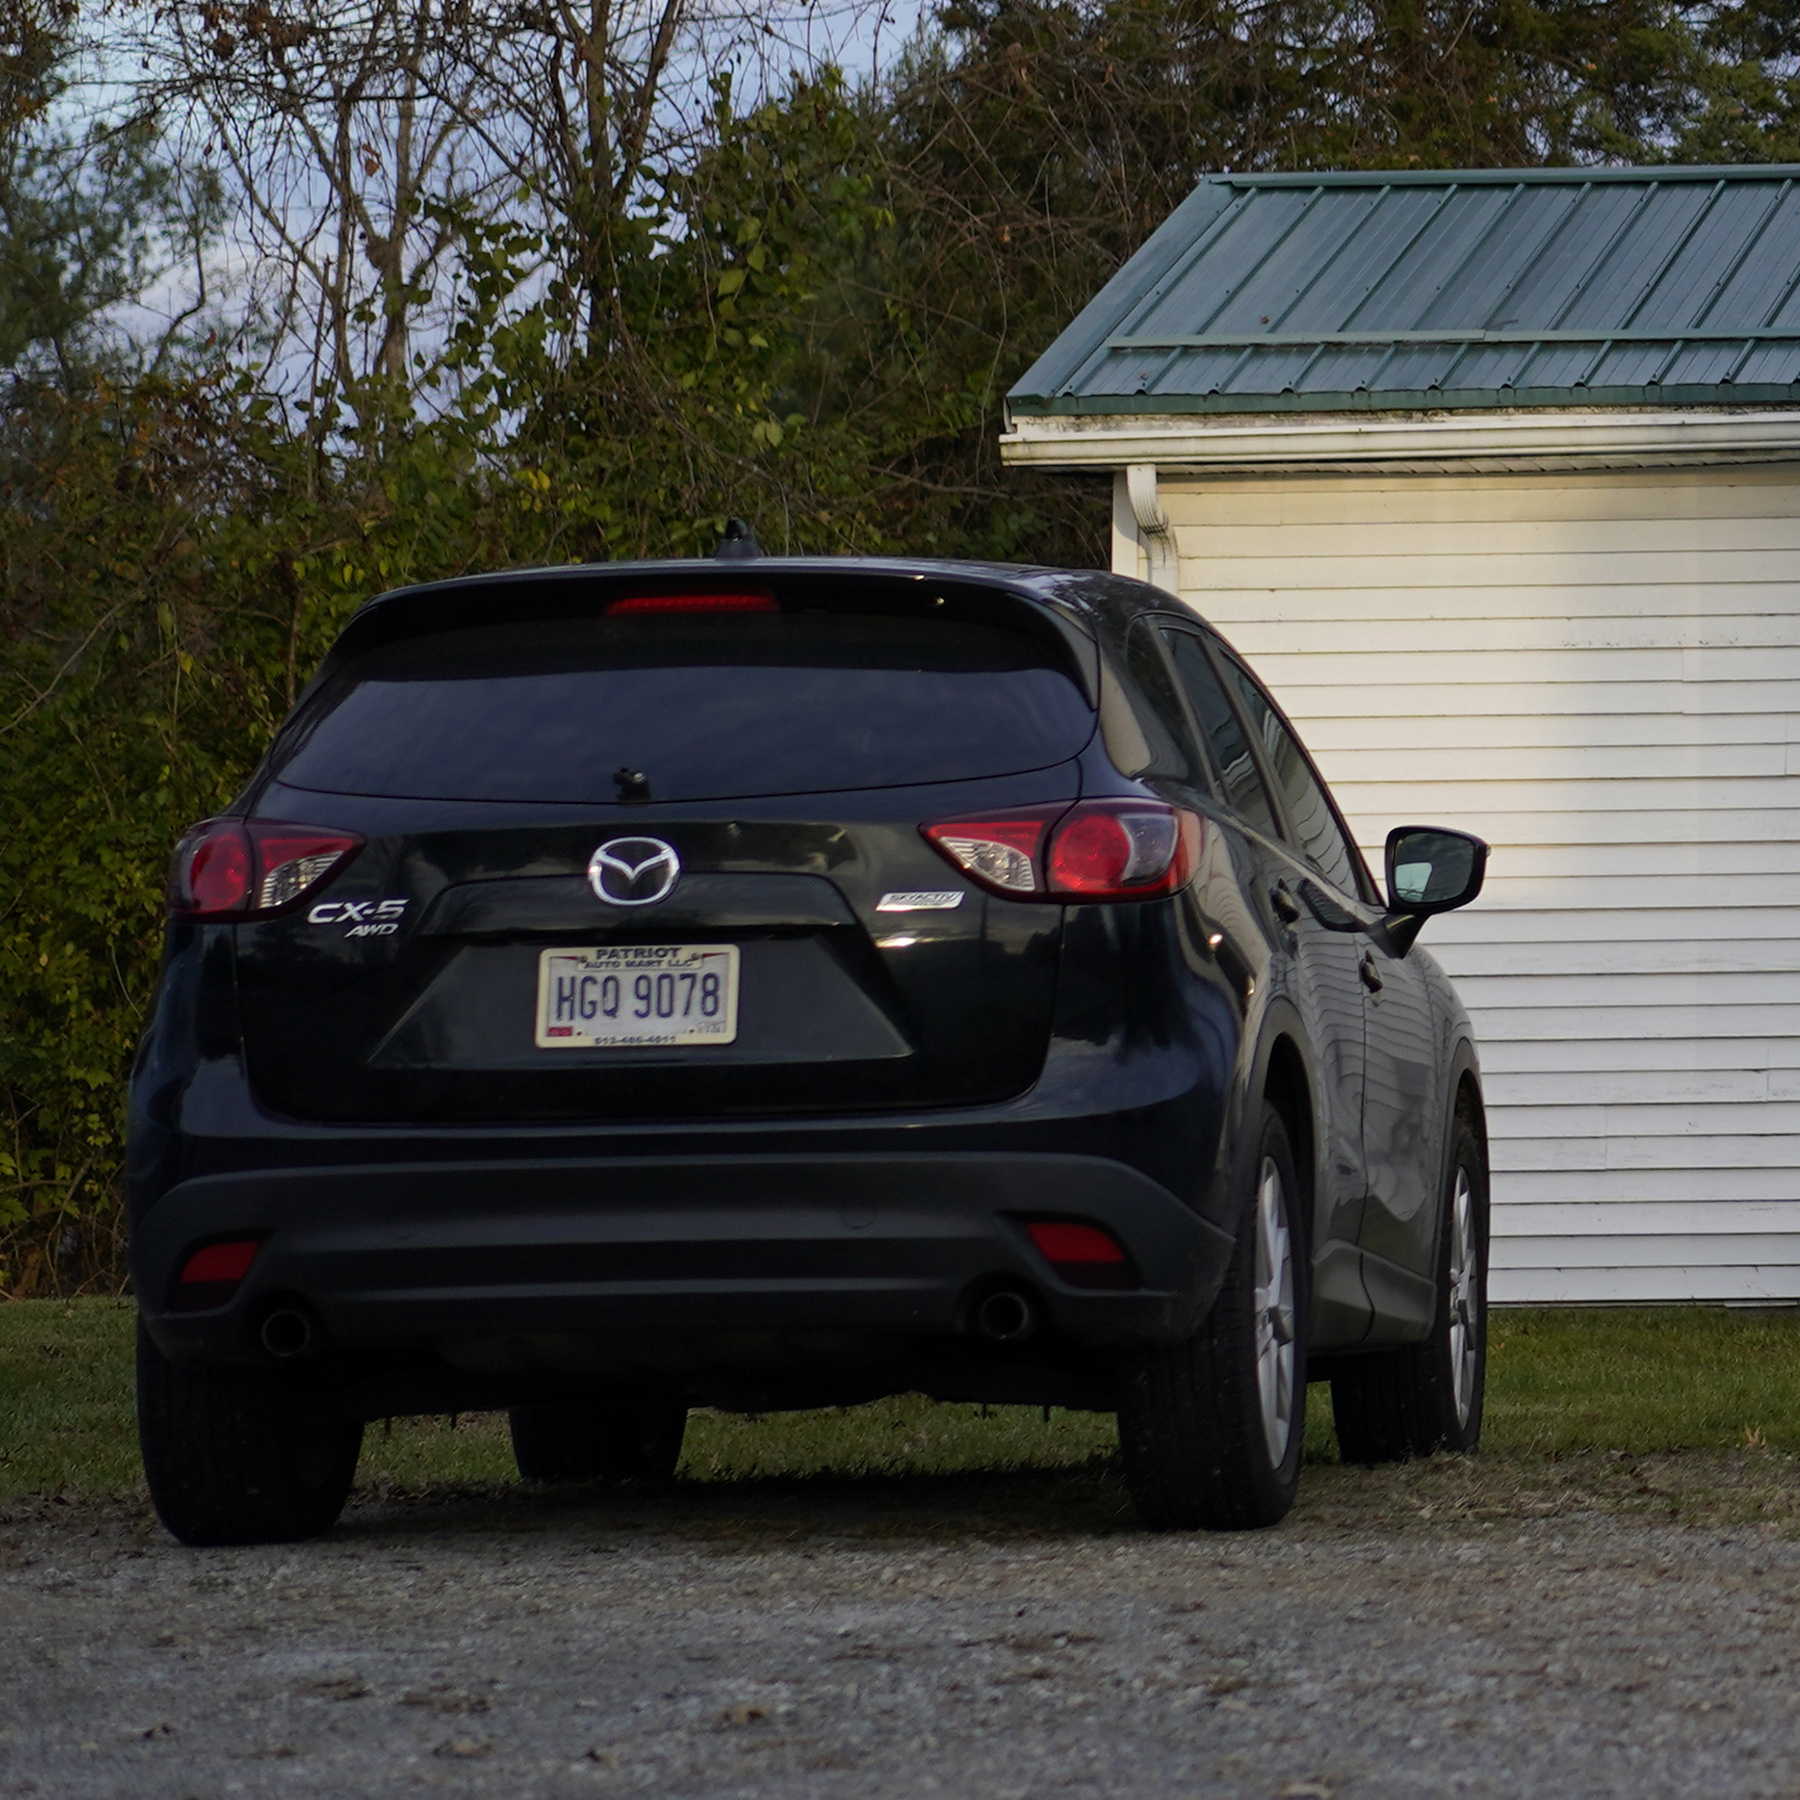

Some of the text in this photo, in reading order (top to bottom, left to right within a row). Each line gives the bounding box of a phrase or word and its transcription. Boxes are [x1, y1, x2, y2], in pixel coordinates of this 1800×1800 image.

[308, 899, 410, 923] CX-5
[343, 923, 399, 938] AWD
[596, 947, 682, 960] PATRIOT
[584, 958, 694, 969] AUTO MART LLC
[555, 972, 720, 1021] HGQ 9078
